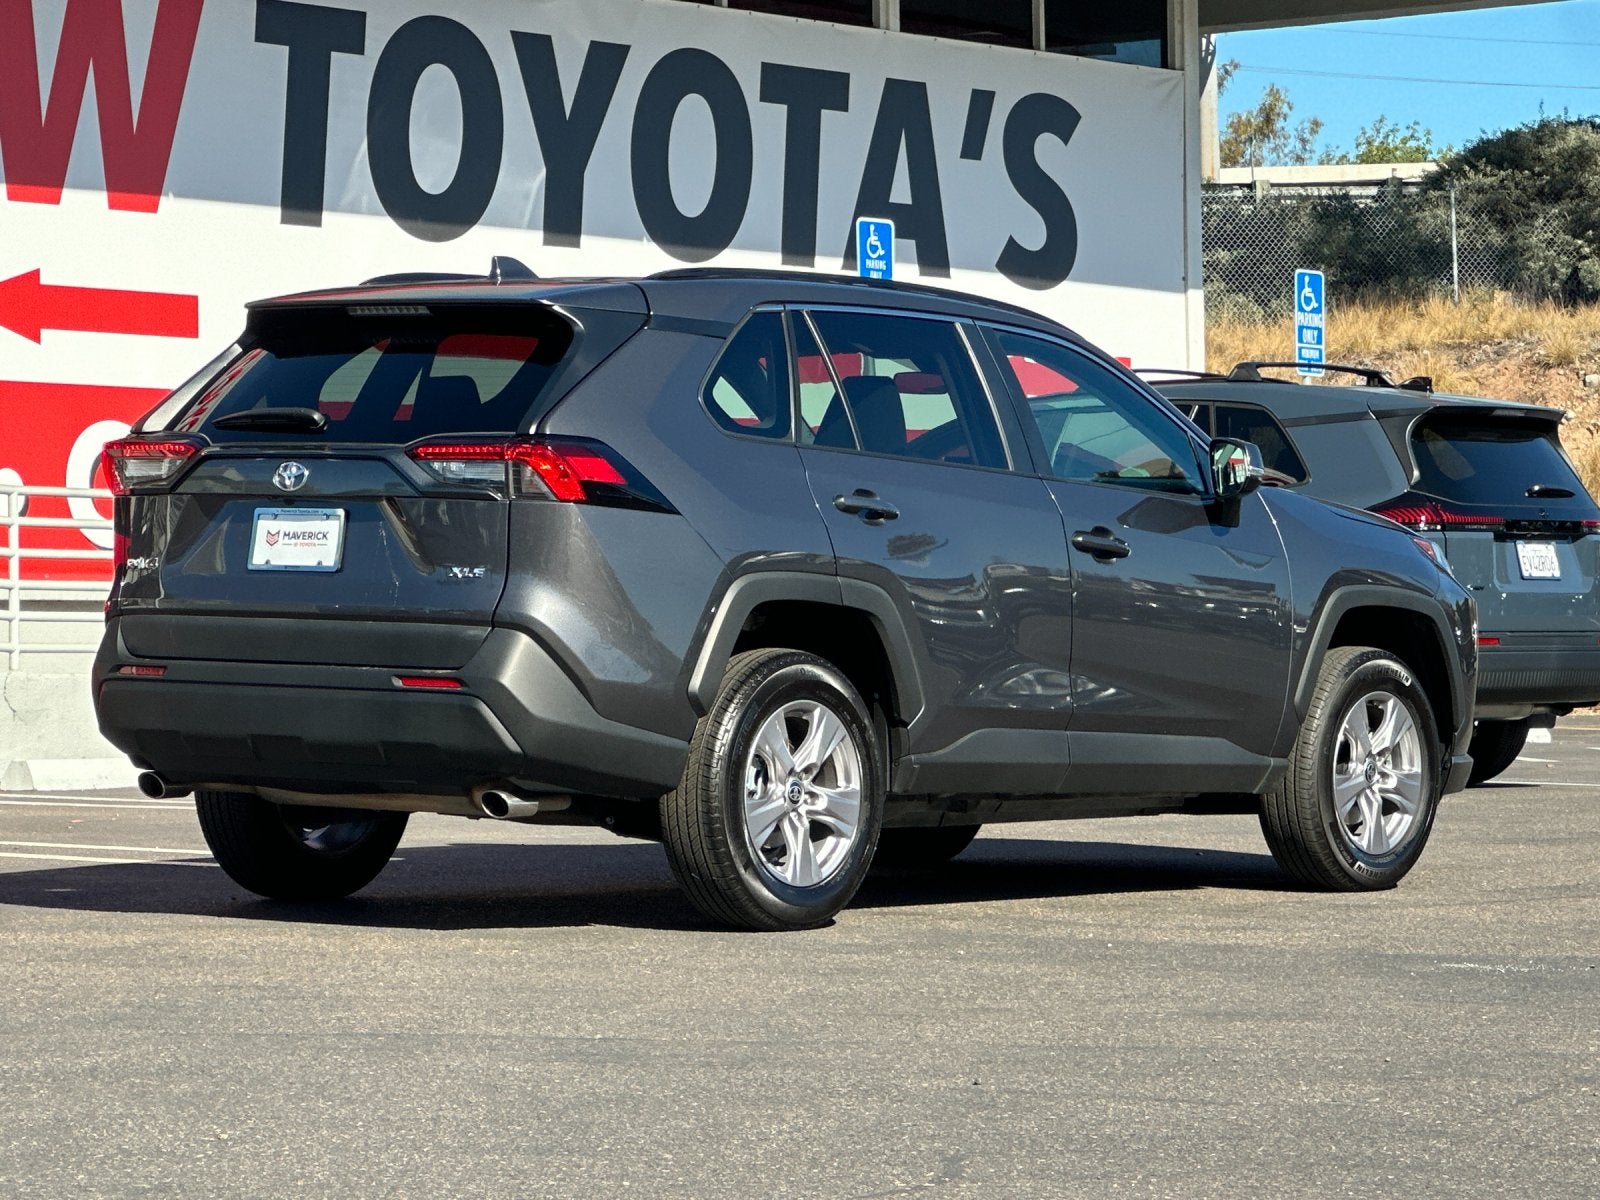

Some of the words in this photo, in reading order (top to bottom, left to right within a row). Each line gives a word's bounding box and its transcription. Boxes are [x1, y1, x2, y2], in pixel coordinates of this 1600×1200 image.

[254, 0, 1082, 290] TOYOTA'S
[1297, 311, 1323, 329] PARKING
[1302, 328, 1319, 344] ONLY
[283, 530, 329, 541] MAVERICK
[448, 566, 486, 579] XLE
